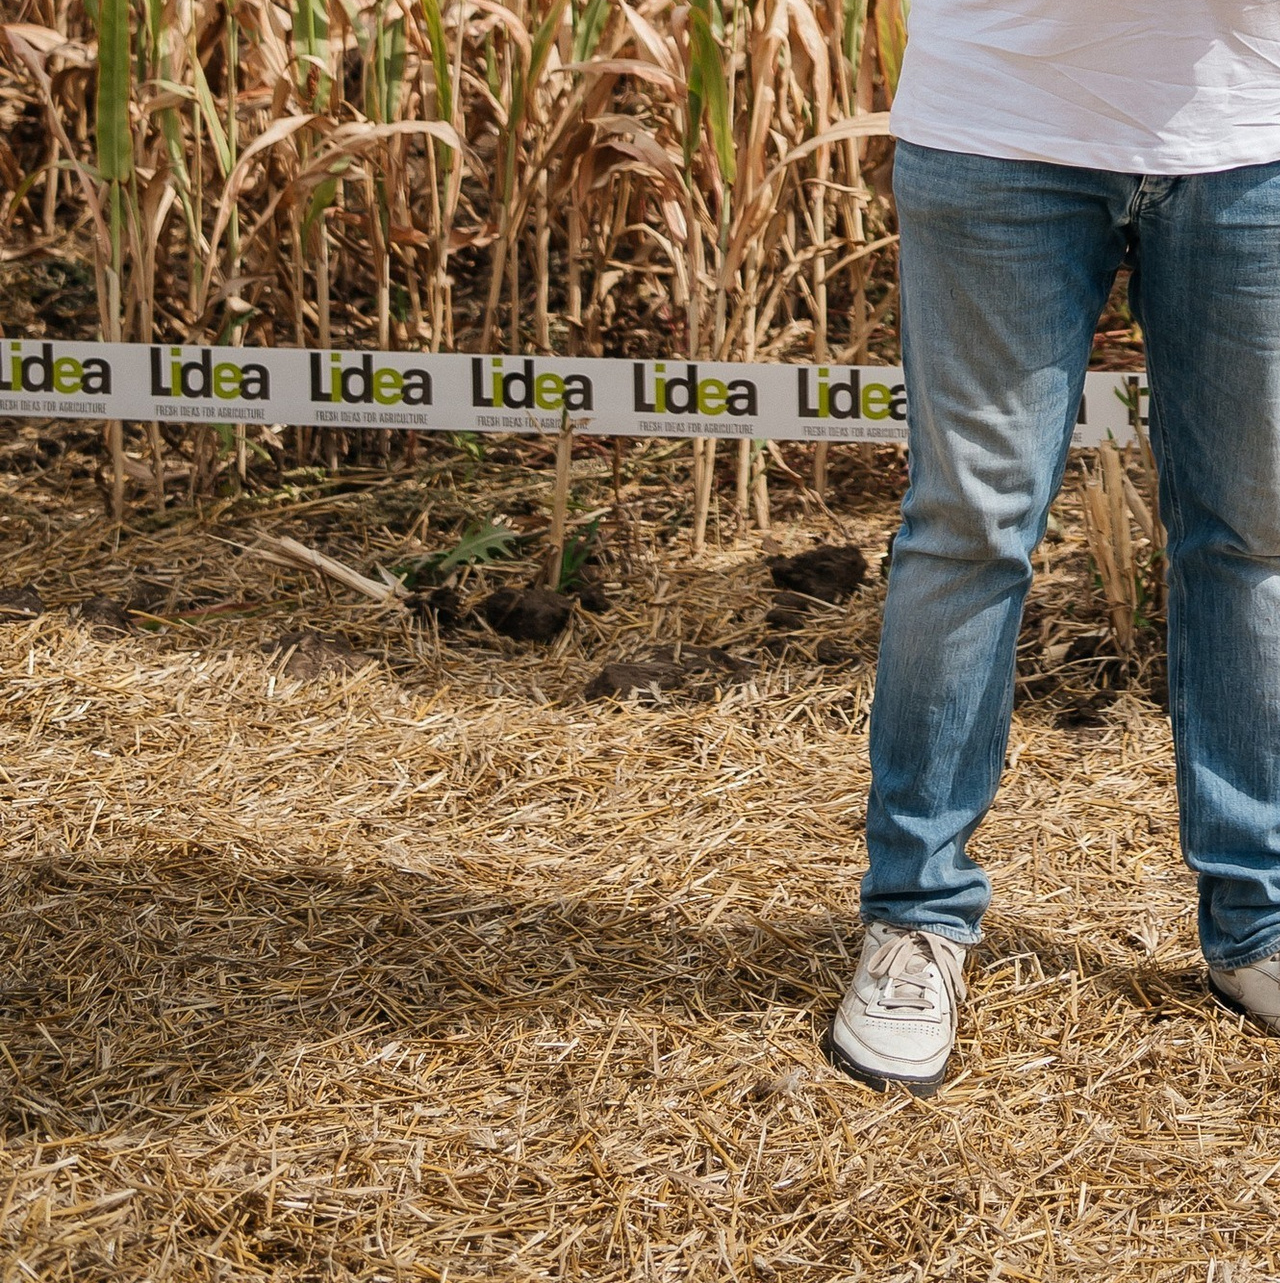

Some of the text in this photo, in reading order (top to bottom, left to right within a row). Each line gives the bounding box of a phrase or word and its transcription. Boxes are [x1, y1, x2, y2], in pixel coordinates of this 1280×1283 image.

[0, 341, 112, 394] idea
[150, 347, 270, 400] Lidea
[310, 352, 433, 405] Lidea
[472, 357, 594, 411] Lidea
[634, 363, 758, 416] Lidea
